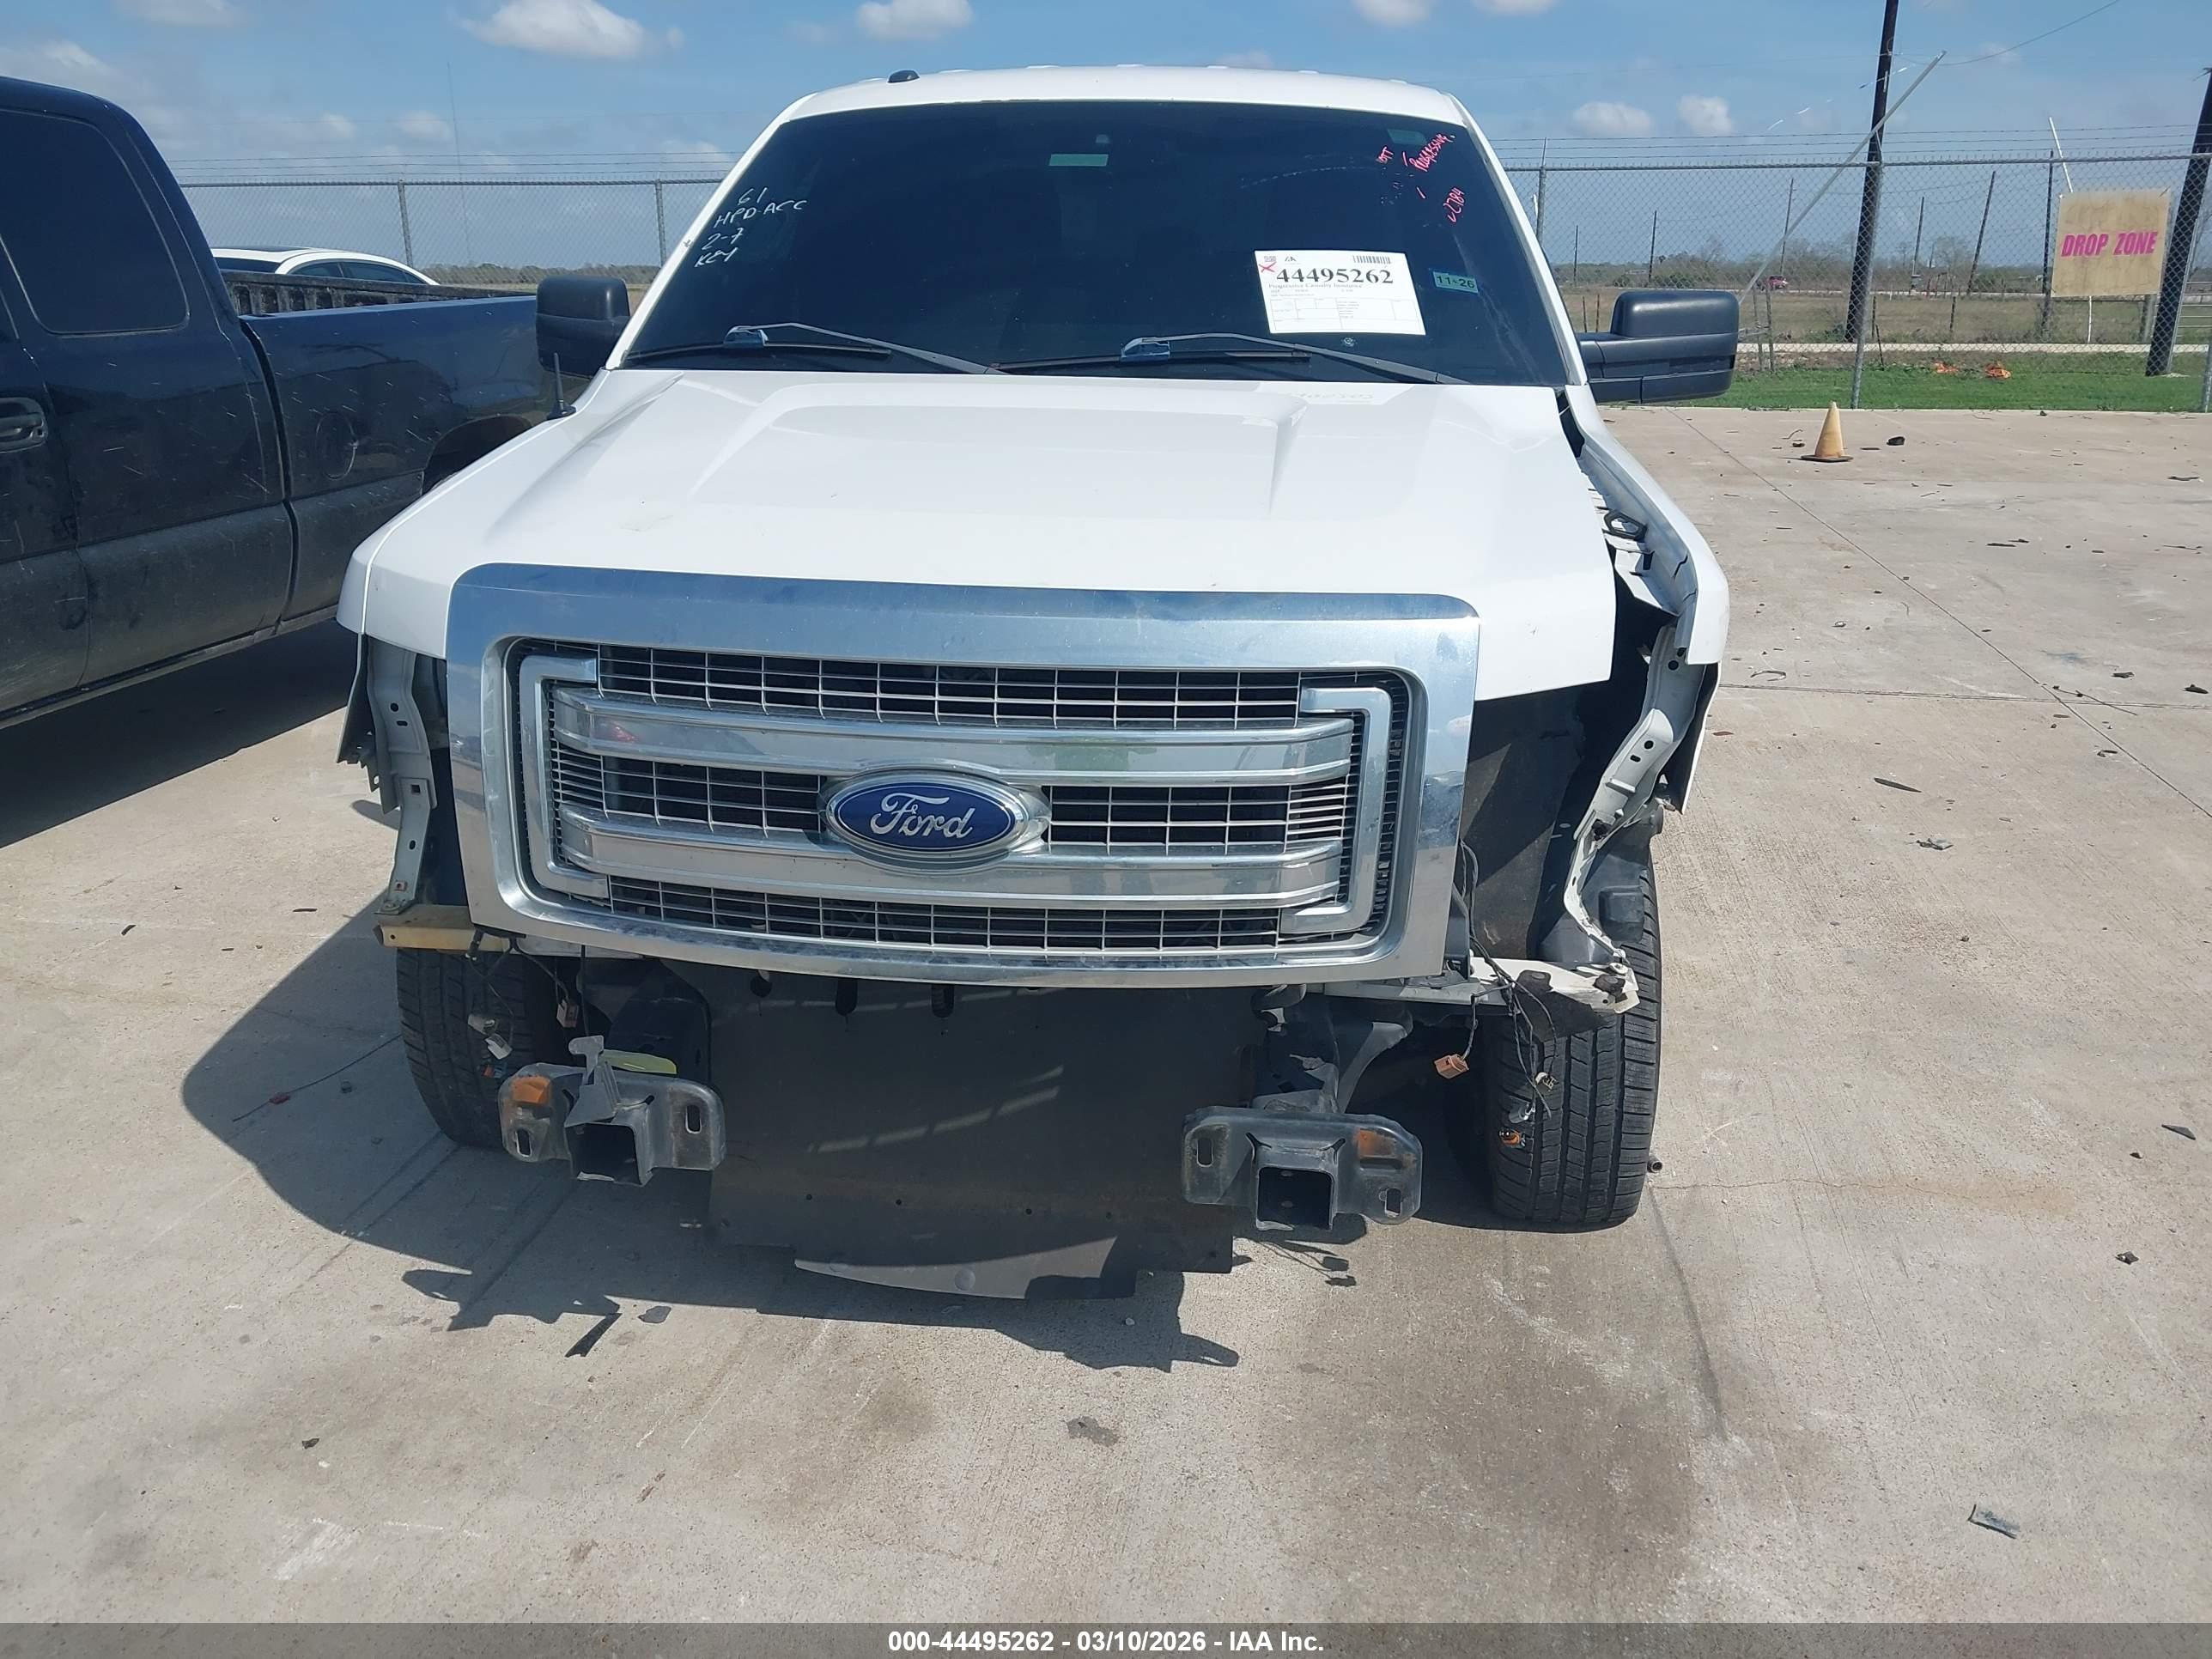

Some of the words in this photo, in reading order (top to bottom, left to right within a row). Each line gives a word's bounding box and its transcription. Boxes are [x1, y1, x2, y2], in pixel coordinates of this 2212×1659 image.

[2061, 233, 2109, 258] DROP
[2112, 231, 2159, 256] ZONE
[1276, 268, 1394, 284] 44495262
[1437, 276, 1475, 289] 11-26
[870, 793, 975, 839] Ford
